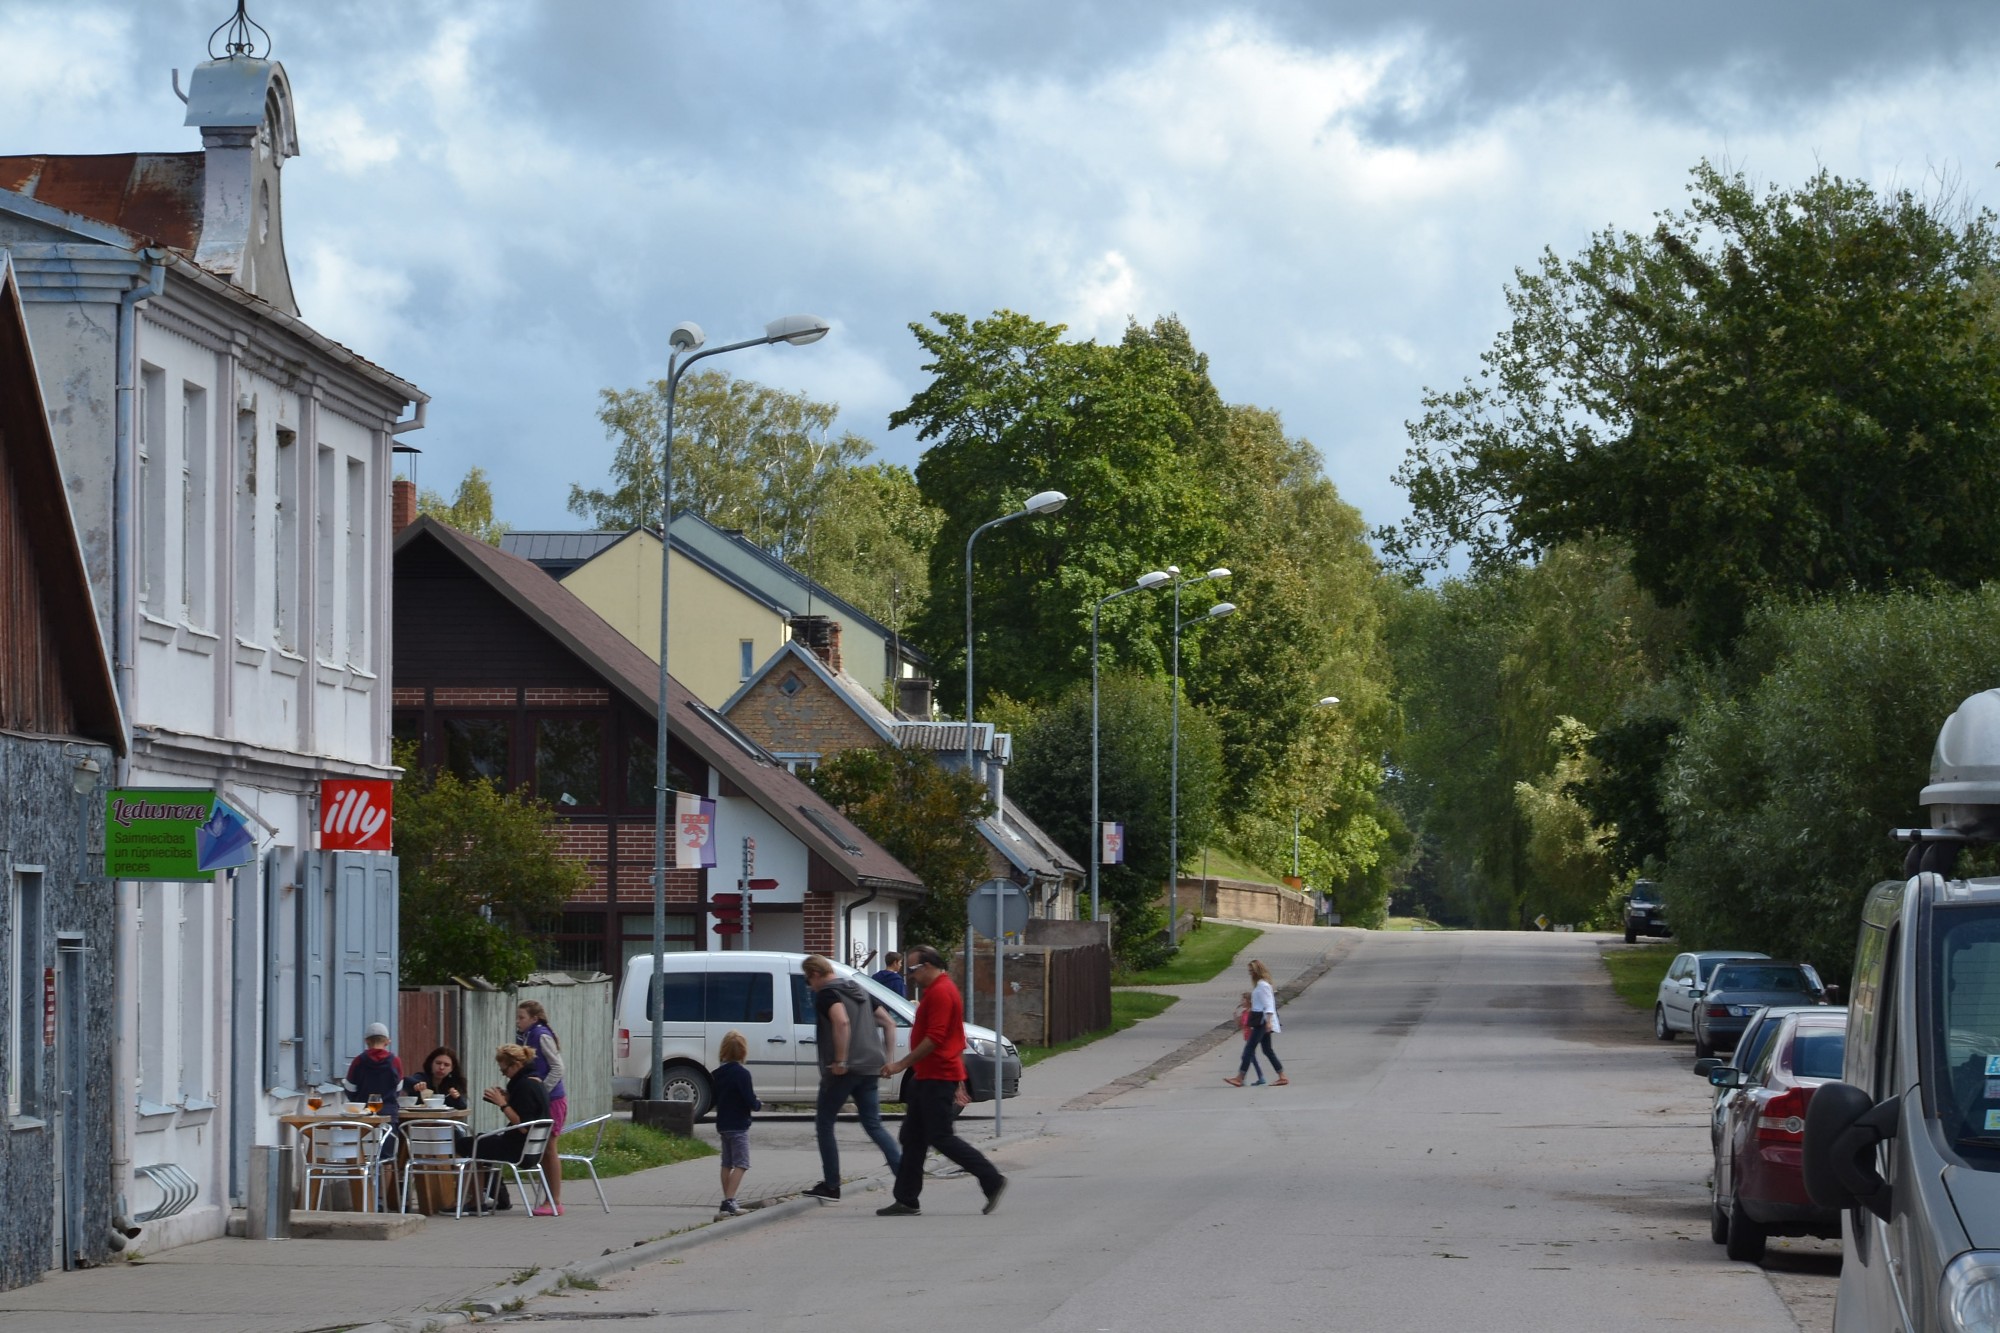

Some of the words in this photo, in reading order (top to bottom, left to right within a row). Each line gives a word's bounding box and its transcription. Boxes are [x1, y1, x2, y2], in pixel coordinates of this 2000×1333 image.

[112, 798, 206, 828] Ledusroze
[323, 788, 387, 845] illy
[114, 848, 128, 858] un
[114, 862, 151, 874] preces
